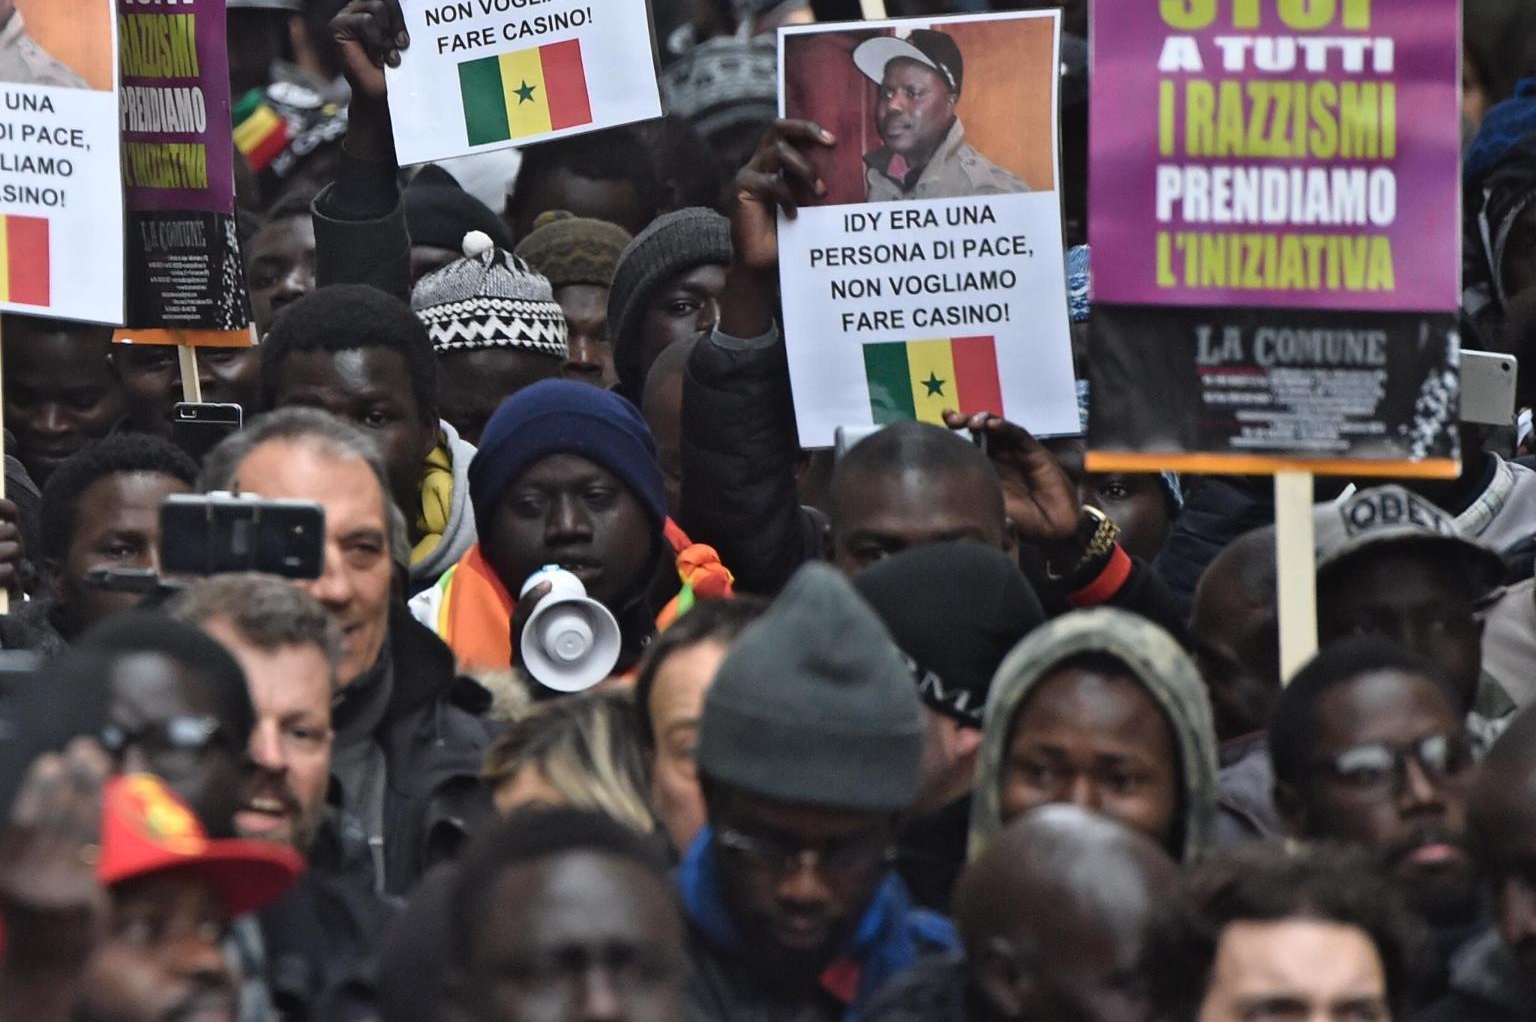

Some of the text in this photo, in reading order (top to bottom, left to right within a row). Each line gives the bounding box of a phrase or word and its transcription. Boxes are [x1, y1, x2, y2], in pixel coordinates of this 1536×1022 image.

[425, 1, 473, 26] NON
[438, 7, 593, 54] FARE CASINO!
[1157, 36, 1395, 72] A TUTTI
[5, 93, 54, 113] UNA
[121, 86, 206, 133] PRENDIAMO
[1159, 80, 1395, 159] I RAZZISMI
[22, 124, 90, 151] PACE,
[1156, 165, 1396, 226] PRENDIAMO
[844, 205, 996, 232] IDY ERA UNA
[810, 236, 1033, 267] PERSONA DI PACE,
[1156, 231, 1395, 291] L'INIZIATIVA
[831, 270, 1016, 299] NON VOGLIAMO
[842, 303, 1010, 332] FARE CASINO!
[1196, 326, 1387, 366] LA COMUNE
